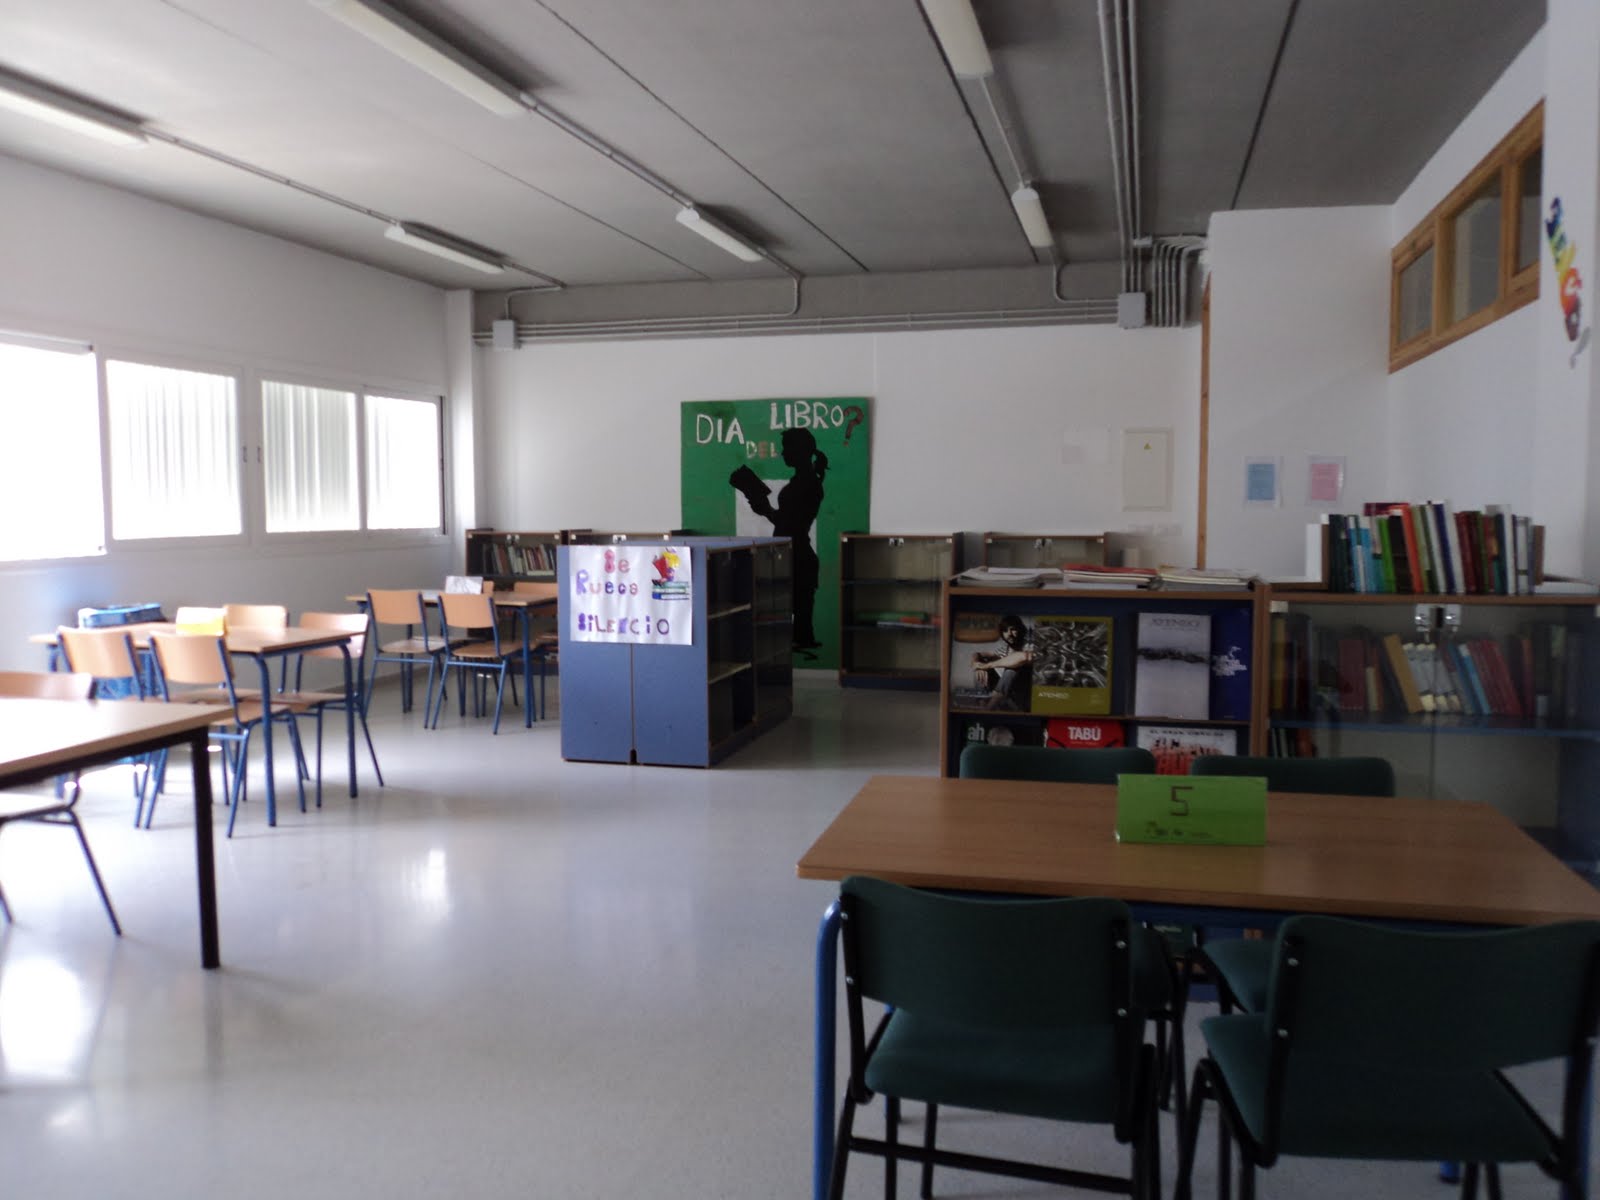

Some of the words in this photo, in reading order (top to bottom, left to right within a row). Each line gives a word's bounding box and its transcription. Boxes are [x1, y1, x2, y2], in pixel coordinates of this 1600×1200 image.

[696, 413, 745, 444] DIA
[746, 440, 778, 459] DEL
[1170, 786, 1194, 816] 5
